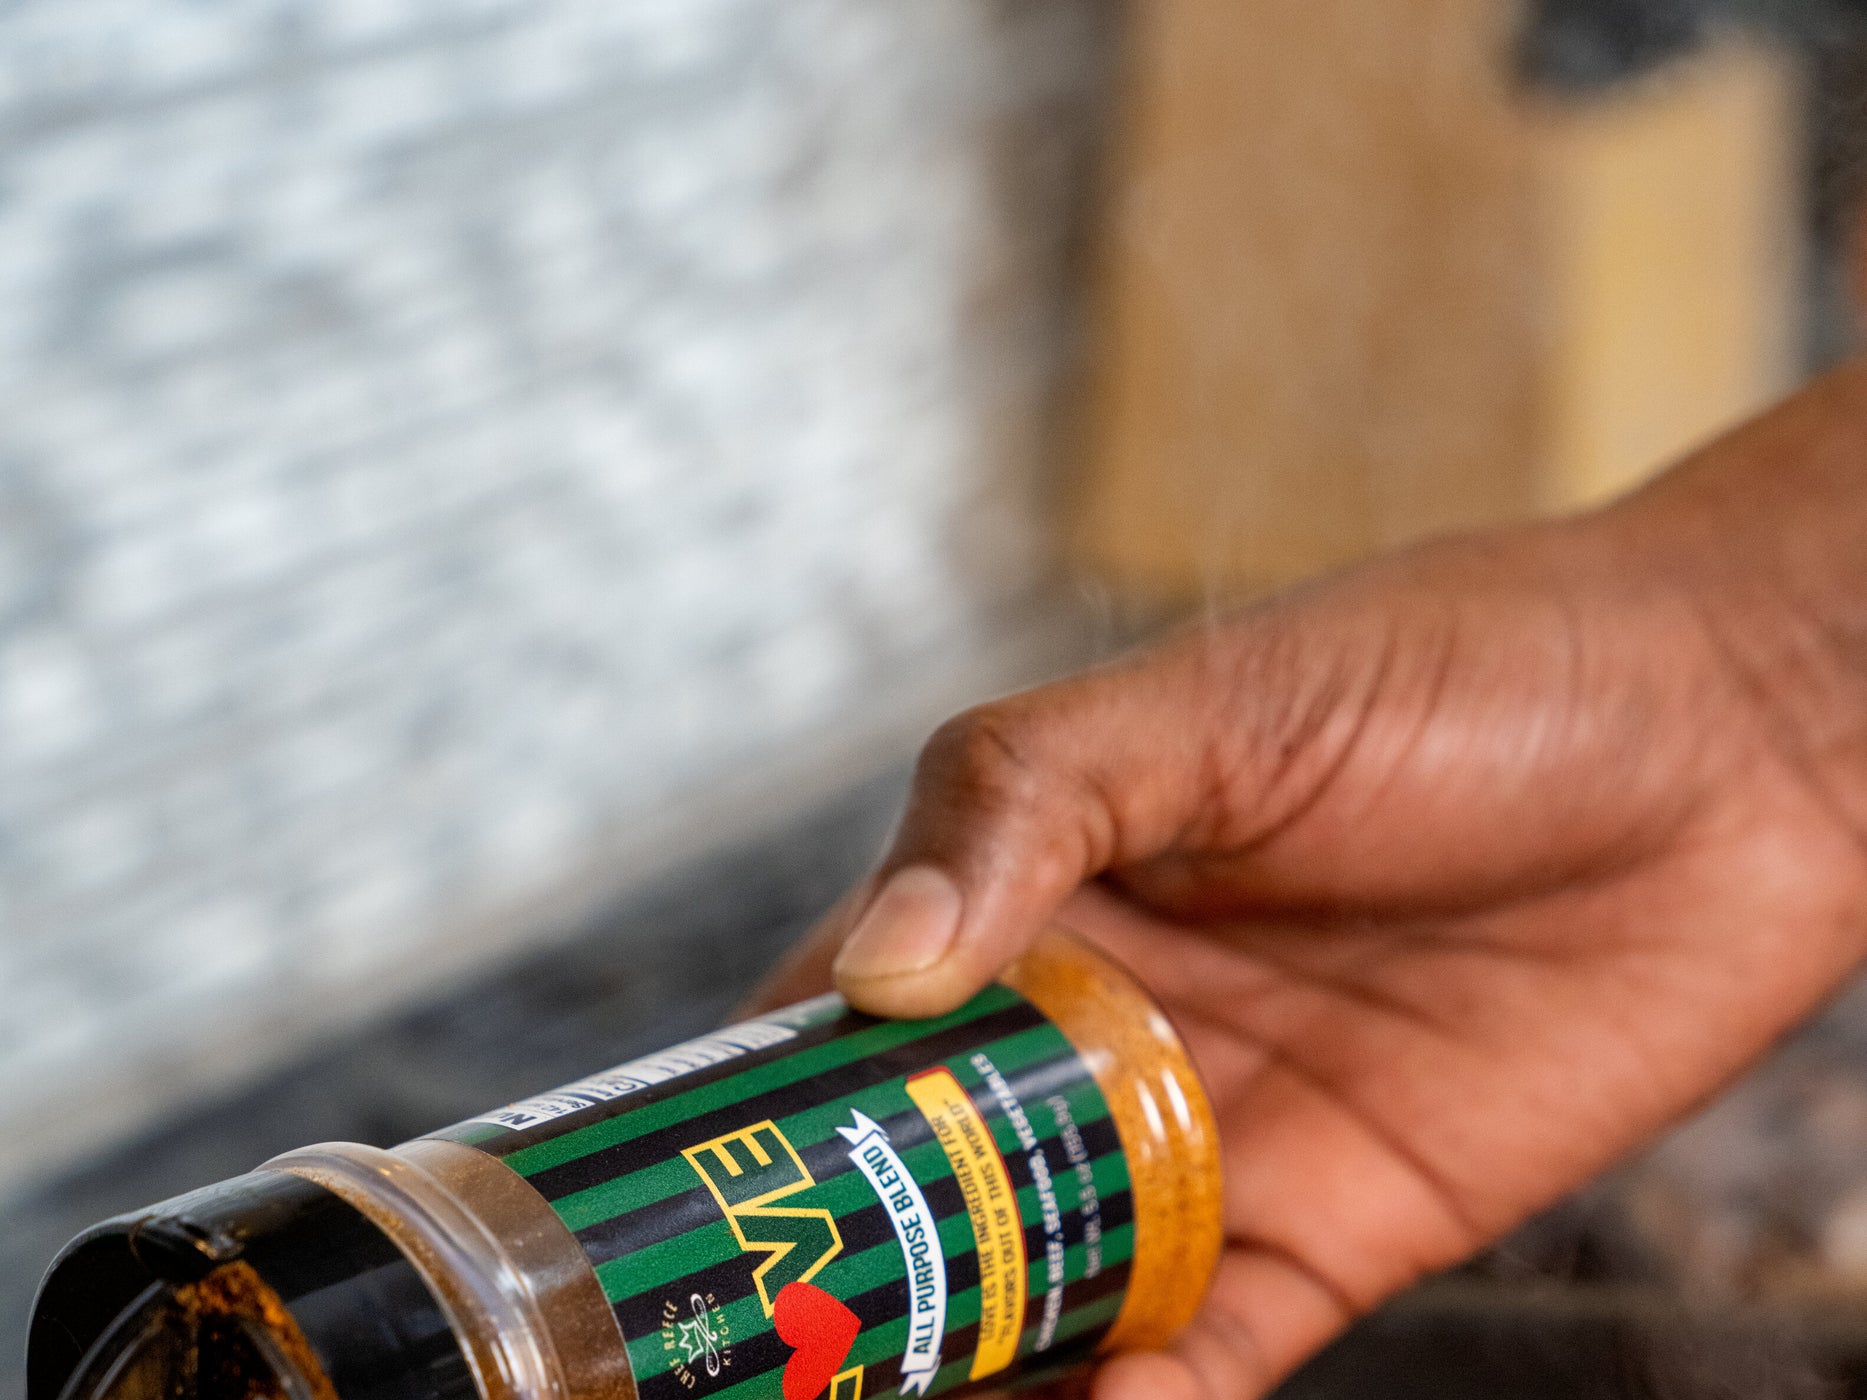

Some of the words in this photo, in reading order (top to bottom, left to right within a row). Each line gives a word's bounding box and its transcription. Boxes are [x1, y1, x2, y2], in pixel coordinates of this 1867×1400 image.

[931, 1113, 958, 1147] FOR
[862, 1144, 915, 1215] BLEND
[950, 1149, 991, 1245] INGREDIENT
[980, 1163, 1003, 1201] THIS
[993, 1207, 1009, 1227] OF
[900, 1212, 937, 1314] PURPOSE
[980, 1248, 996, 1278] THE
[999, 1231, 1016, 1264] OUT
[982, 1281, 997, 1300] IS
[662, 1300, 678, 1350] REECE
[705, 1293, 732, 1367] KITCHEN
[913, 1315, 936, 1355] ALL
[668, 1357, 696, 1390] CHEF
